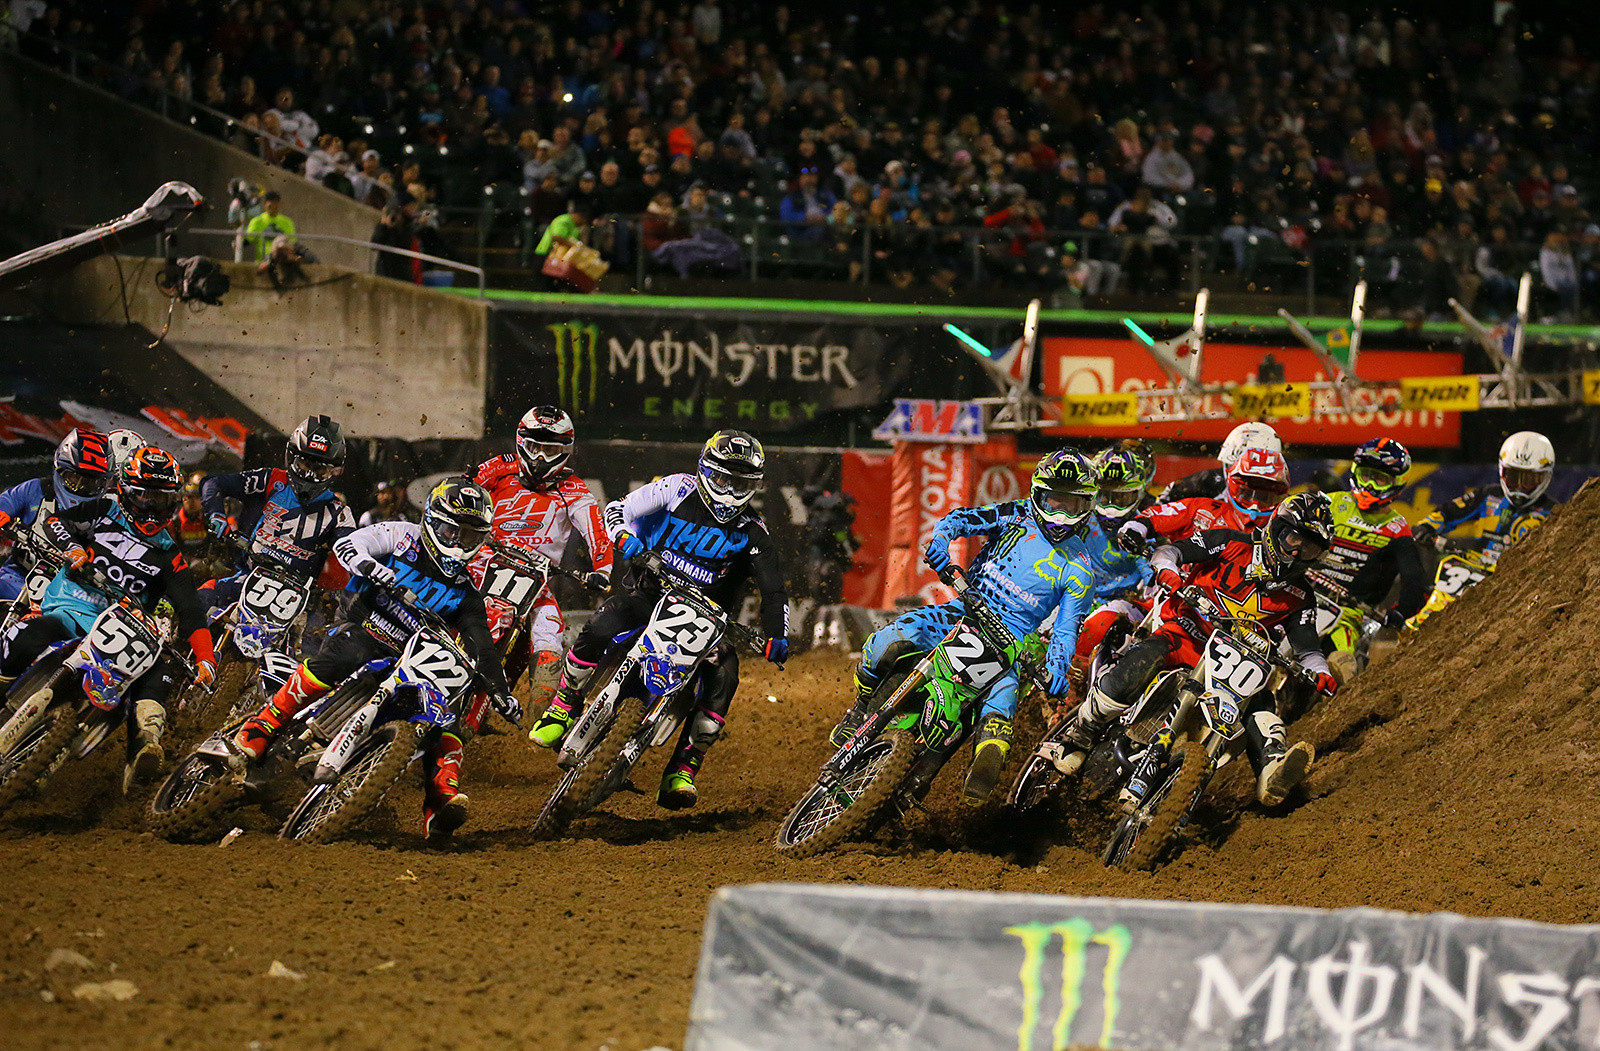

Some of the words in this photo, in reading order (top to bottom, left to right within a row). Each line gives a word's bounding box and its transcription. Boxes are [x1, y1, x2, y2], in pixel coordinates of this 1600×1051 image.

[608, 330, 858, 389] MONSTER
[643, 396, 820, 421] ENERGY
[872, 398, 986, 443] AMA
[664, 515, 749, 560] THOR
[388, 560, 467, 617] THOR
[486, 567, 536, 608] 11
[671, 557, 714, 584] YAMAHA
[984, 559, 1040, 608] Kawasaki
[246, 576, 303, 621] 59
[92, 618, 153, 677] 53
[654, 603, 717, 653] 23
[408, 641, 470, 698] 122
[944, 633, 1004, 690] 24
[1211, 643, 1264, 696] 30
[839, 734, 870, 770] UNLOP
